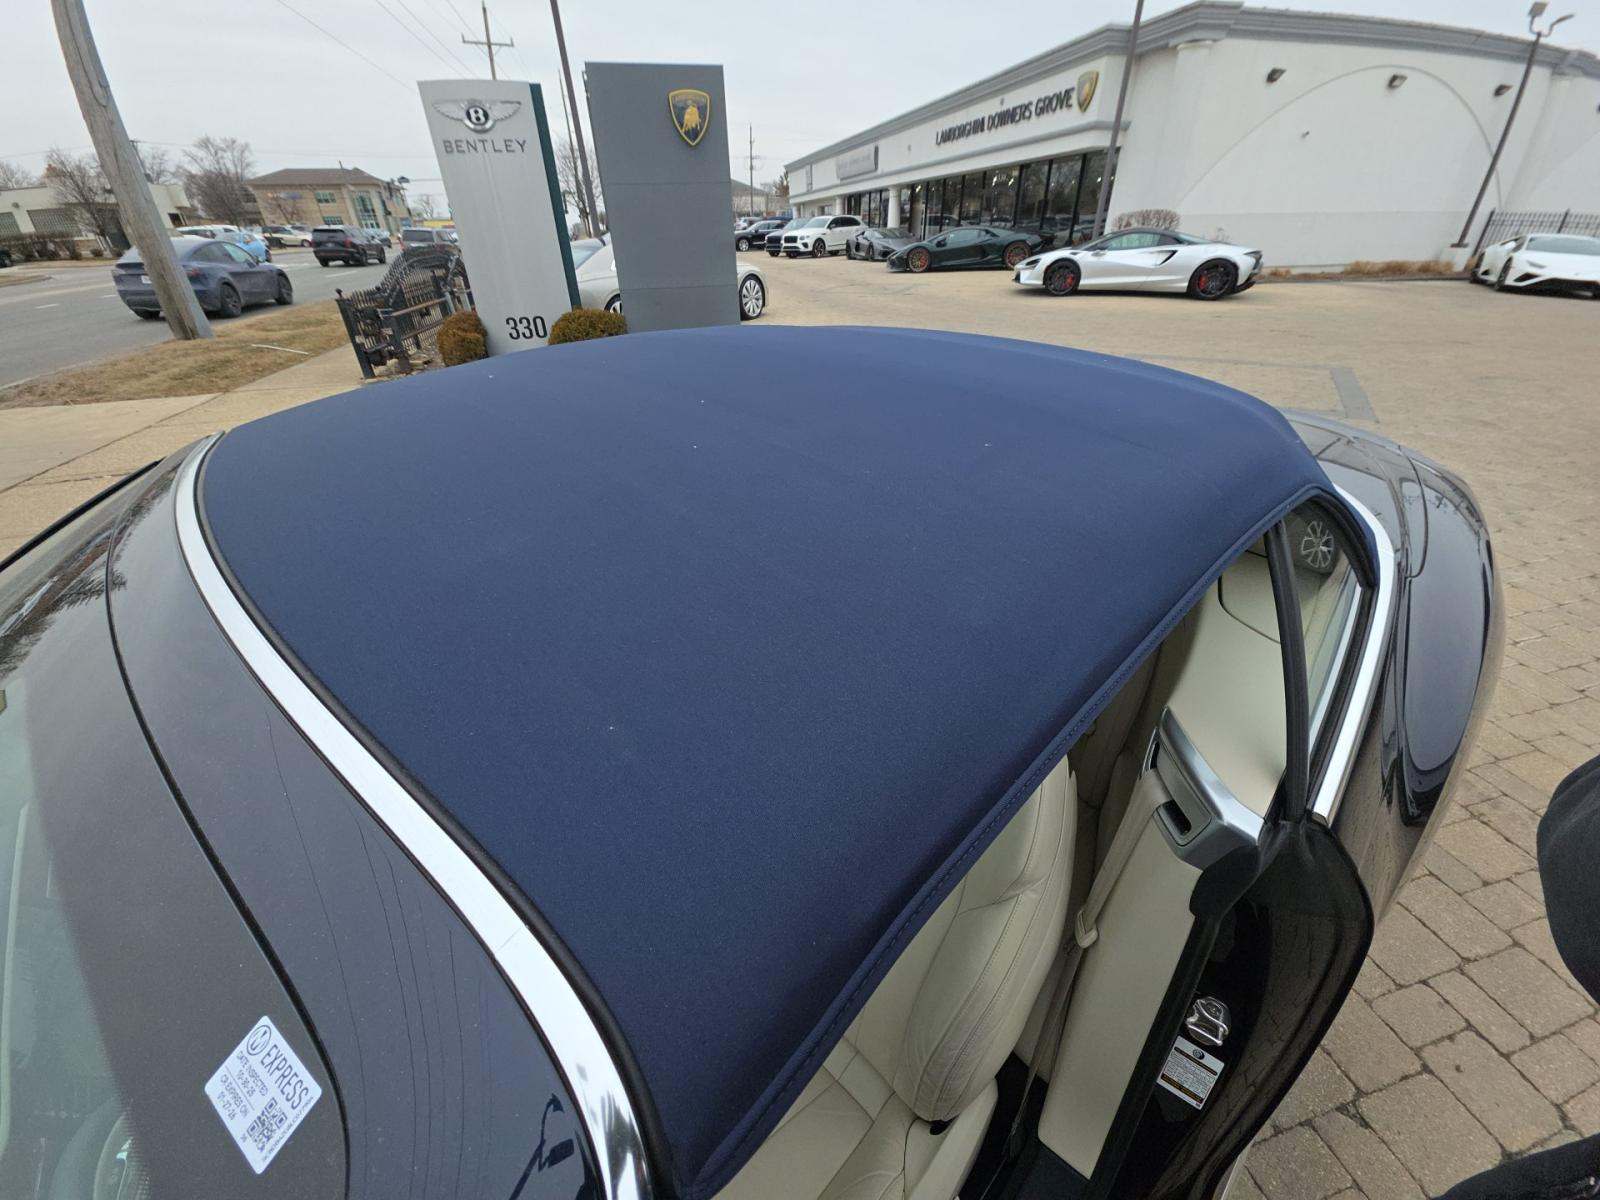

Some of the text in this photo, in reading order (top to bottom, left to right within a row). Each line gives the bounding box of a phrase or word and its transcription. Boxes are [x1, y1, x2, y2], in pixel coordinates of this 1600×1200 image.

[935, 87, 1075, 146] LAMBORGHINI DOWNERS GROVE
[442, 138, 526, 154] BENTLEY
[505, 315, 548, 340] 330
[261, 1044, 309, 1110] EXPRESS
